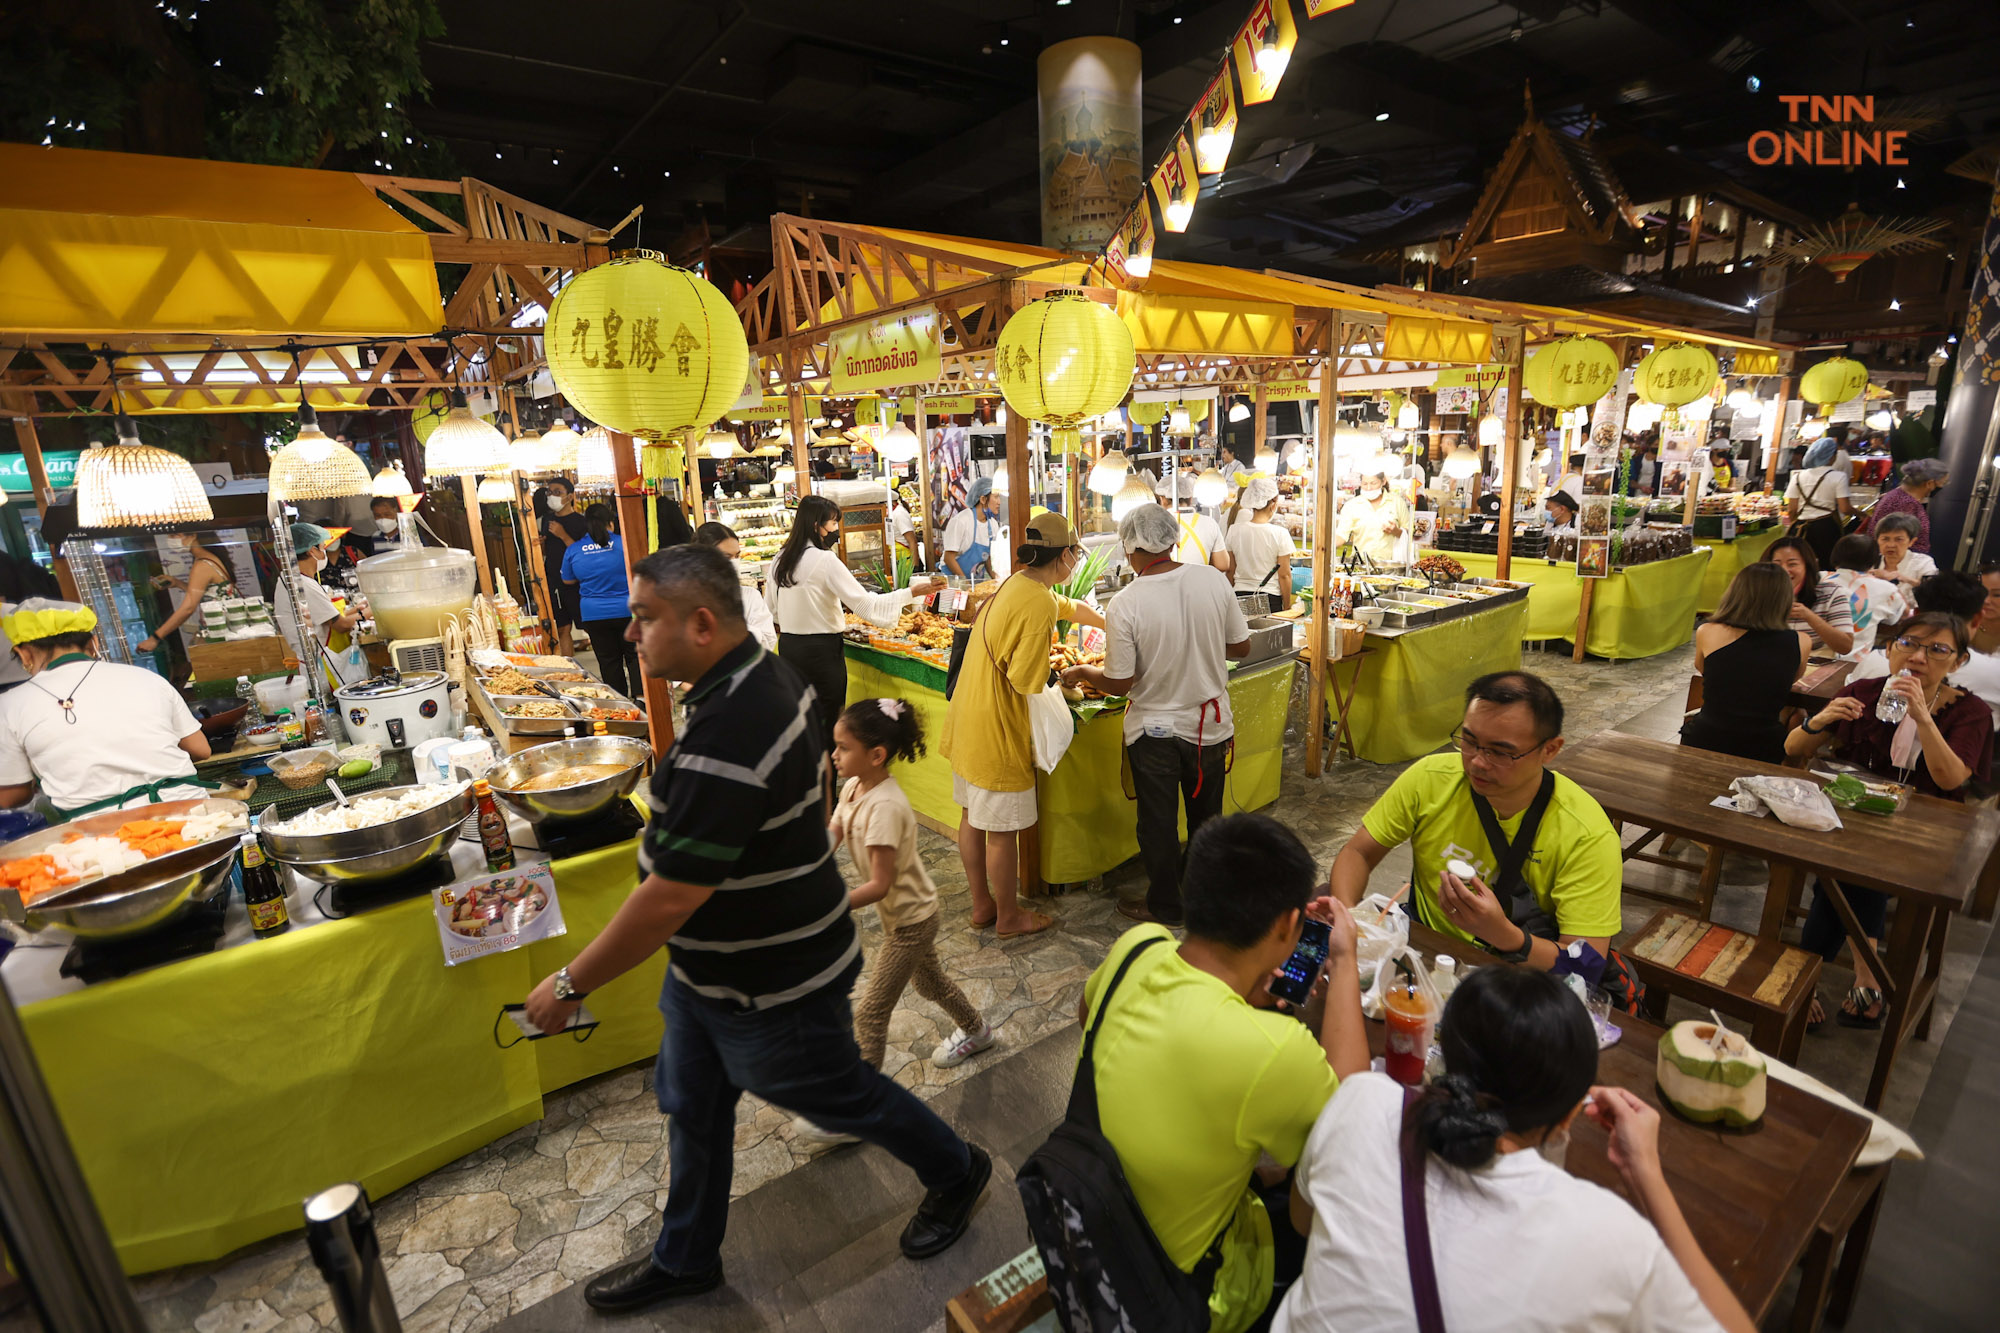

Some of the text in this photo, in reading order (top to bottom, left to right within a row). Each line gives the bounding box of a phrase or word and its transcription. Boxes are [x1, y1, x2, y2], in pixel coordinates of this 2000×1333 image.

[569, 307, 702, 378] 九皇勝會
[1557, 359, 1614, 385] 九皇勝會
[1652, 367, 1706, 389] 九皇勝會
[1294, 384, 1312, 394] Fru
[923, 399, 959, 408] esh Fruit
[12, 457, 79, 476] Can
[581, 540, 615, 552] COWY
[503, 934, 517, 946] 80
